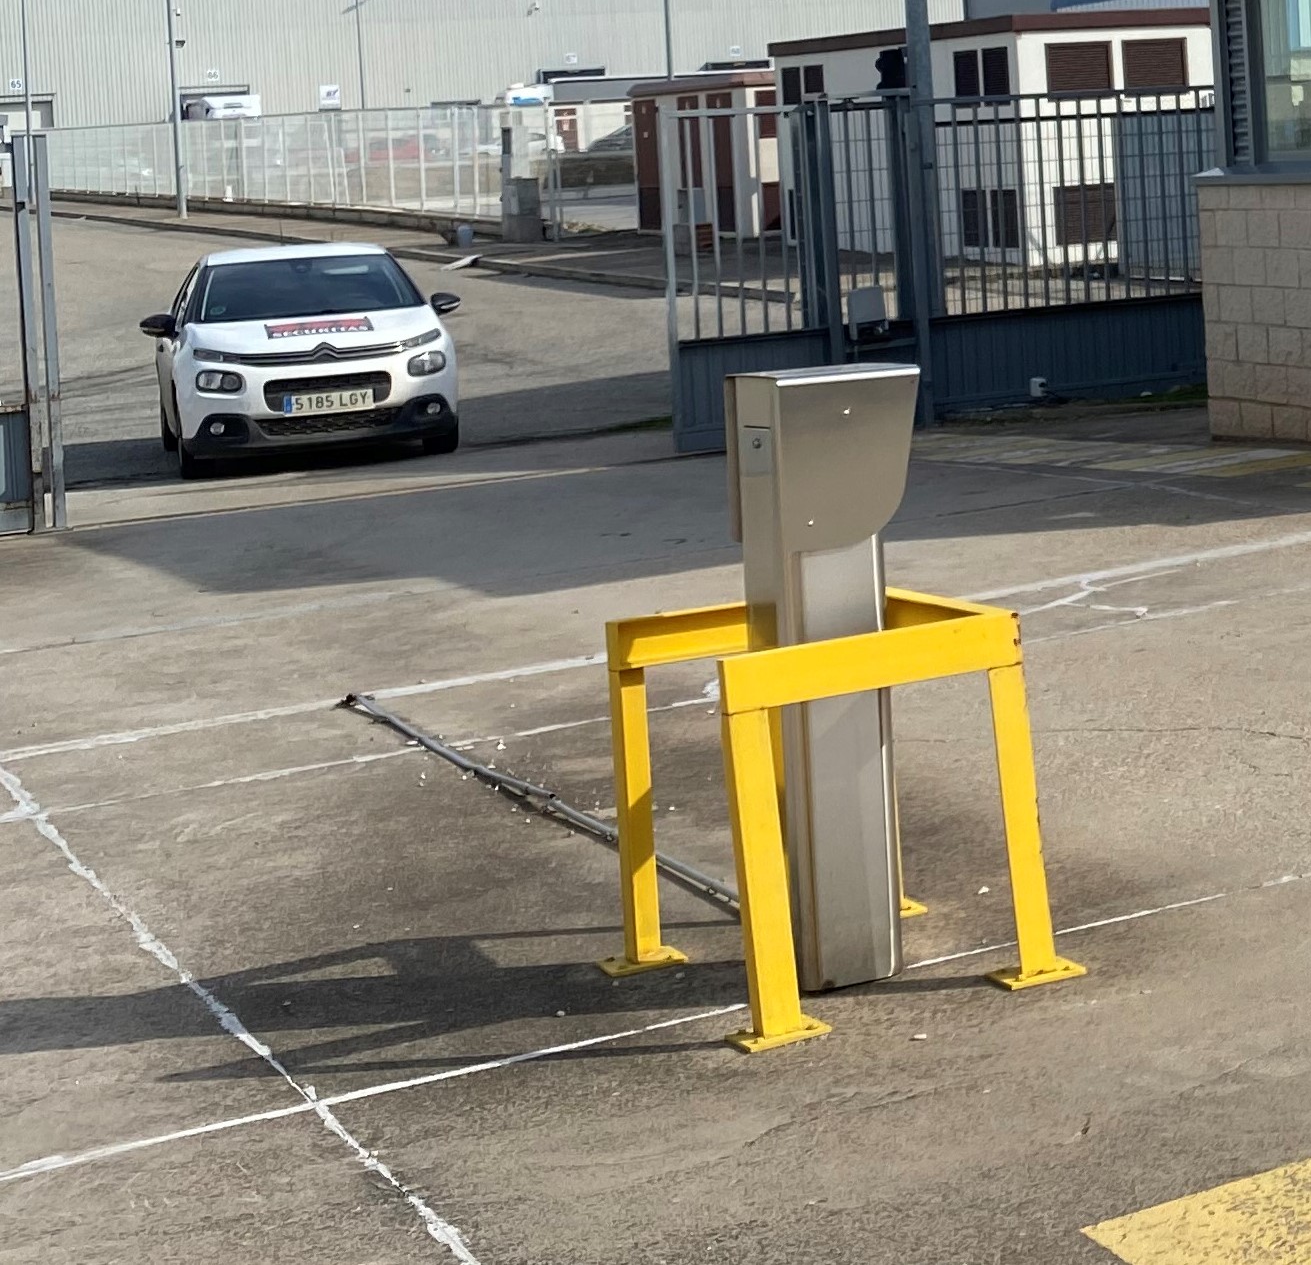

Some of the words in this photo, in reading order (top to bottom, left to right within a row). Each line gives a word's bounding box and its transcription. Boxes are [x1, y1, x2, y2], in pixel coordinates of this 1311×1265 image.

[10, 79, 22, 89] 65
[295, 394, 334, 411] 5185
[339, 390, 368, 407] LGY
